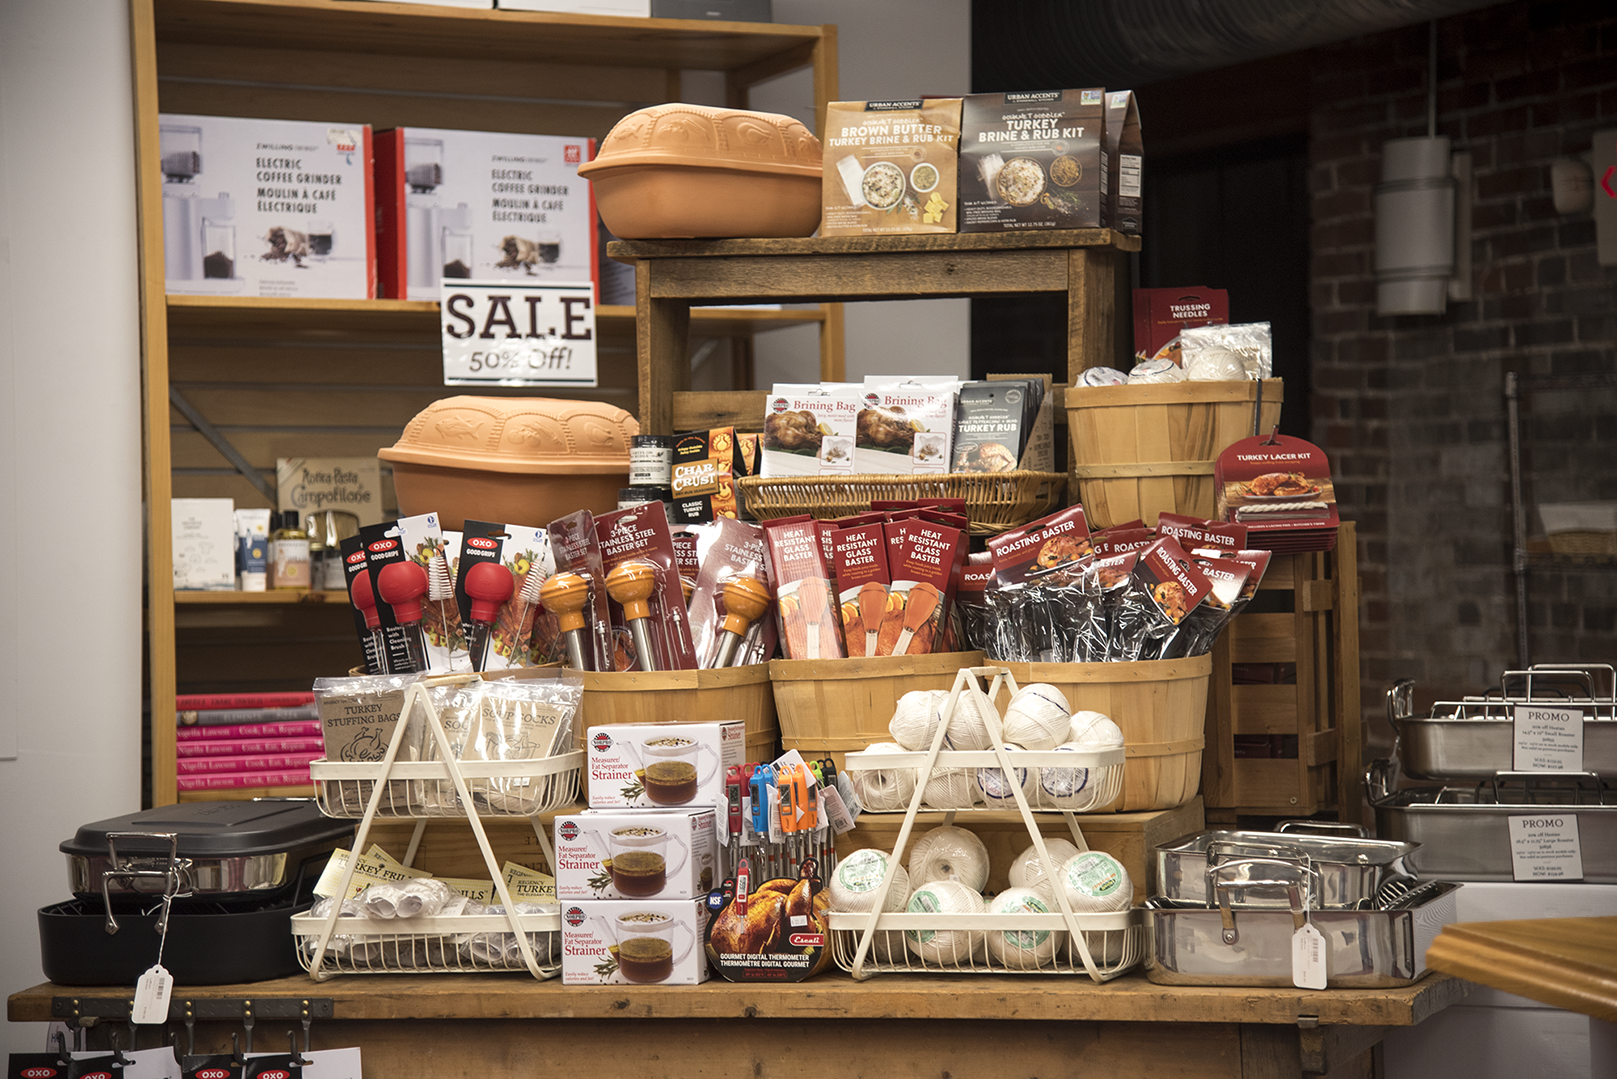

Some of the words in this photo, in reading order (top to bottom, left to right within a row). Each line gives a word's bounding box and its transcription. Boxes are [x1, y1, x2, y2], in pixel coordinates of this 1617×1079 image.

[841, 125, 889, 138] BROWN
[893, 124, 942, 135] BUTTER
[1006, 119, 1059, 131] TURKEY
[829, 137, 867, 147] TURKEY
[869, 136, 900, 145] BRINE
[902, 135, 910, 143] &
[912, 134, 934, 143] RUB
[935, 134, 954, 142] KIT
[978, 131, 1018, 142] BRINE
[1020, 130, 1030, 141] &
[1032, 128, 1060, 140] RUB
[1062, 127, 1085, 138] KIT
[256, 157, 302, 170] ELECTRIC
[256, 171, 293, 183] COFFEE
[296, 173, 342, 185] GRINDER
[491, 169, 533, 181] ELECTRIC
[257, 187, 298, 199] MOULIN
[491, 183, 525, 194] COFFEE
[527, 184, 569, 196] GRINDER
[492, 198, 530, 209] MOULIN
[1169, 303, 1211, 312] TRUSSING
[446, 294, 592, 340] SALE
[1172, 310, 1208, 319] NEEDLES
[469, 350, 519, 372] 50%
[528, 346, 573, 370] Off!
[793, 400, 833, 412] Brining
[836, 401, 856, 412] Bag
[884, 395, 924, 407] Brining
[927, 395, 947, 407] Bag
[958, 423, 996, 432] TURKEY
[997, 423, 1017, 431] RUB
[333, 467, 359, 485] Pasta
[675, 463, 714, 478] CHAR
[673, 472, 716, 491] CRUST
[290, 483, 371, 509] Campofilone
[610, 524, 637, 538] 3-PIECE
[635, 529, 656, 540] STEEL
[783, 530, 804, 539] HEAT
[921, 529, 942, 540] HEAT
[1161, 526, 1202, 541] ROASTING
[1204, 533, 1235, 546] BASTER
[472, 540, 493, 548] OXO
[774, 535, 816, 548] RESISTANT
[845, 533, 866, 543] HEAT
[908, 534, 951, 551] RESISTANT
[996, 534, 1041, 557] ROASTING
[1042, 521, 1075, 539] BASTER
[373, 541, 393, 550] OXO
[606, 543, 634, 556] BASTER
[635, 539, 649, 548] SET
[783, 544, 810, 554] GLASS
[837, 539, 878, 552] RESISTANT
[914, 545, 941, 556] GLASS
[371, 553, 385, 561] GOOD
[783, 551, 813, 562] BASTER
[846, 548, 872, 559] GLASS
[911, 552, 941, 565] BASTER
[685, 558, 698, 566] SET
[845, 556, 875, 567] BASTER
[964, 573, 990, 581] ROAS
[1156, 546, 1181, 576] ROASTING
[1177, 572, 1198, 596] BASTER
[1203, 567, 1235, 581] BASTER
[344, 704, 383, 715] TURKEY
[327, 716, 375, 728] STUFFING
[377, 713, 401, 723] BAGS
[1528, 712, 1570, 722] PROMO
[176, 728, 200, 739] Nigella
[202, 727, 230, 737] Lawson
[279, 724, 303, 735] Repeat
[178, 746, 203, 755] Nigella
[206, 744, 233, 753] Lawson
[281, 742, 306, 751] Repeat
[591, 756, 621, 764] Measurer/
[591, 769, 633, 781] Strainer
[1522, 819, 1564, 829] PROMO
[558, 845, 587, 853] Measurer/
[558, 859, 600, 870] Strainer
[517, 885, 555, 894] TURKE
[564, 931, 594, 939] Measurer/
[574, 938, 602, 946] Separator
[565, 945, 607, 956] Strainer
[202, 1071, 224, 1079] OXO
